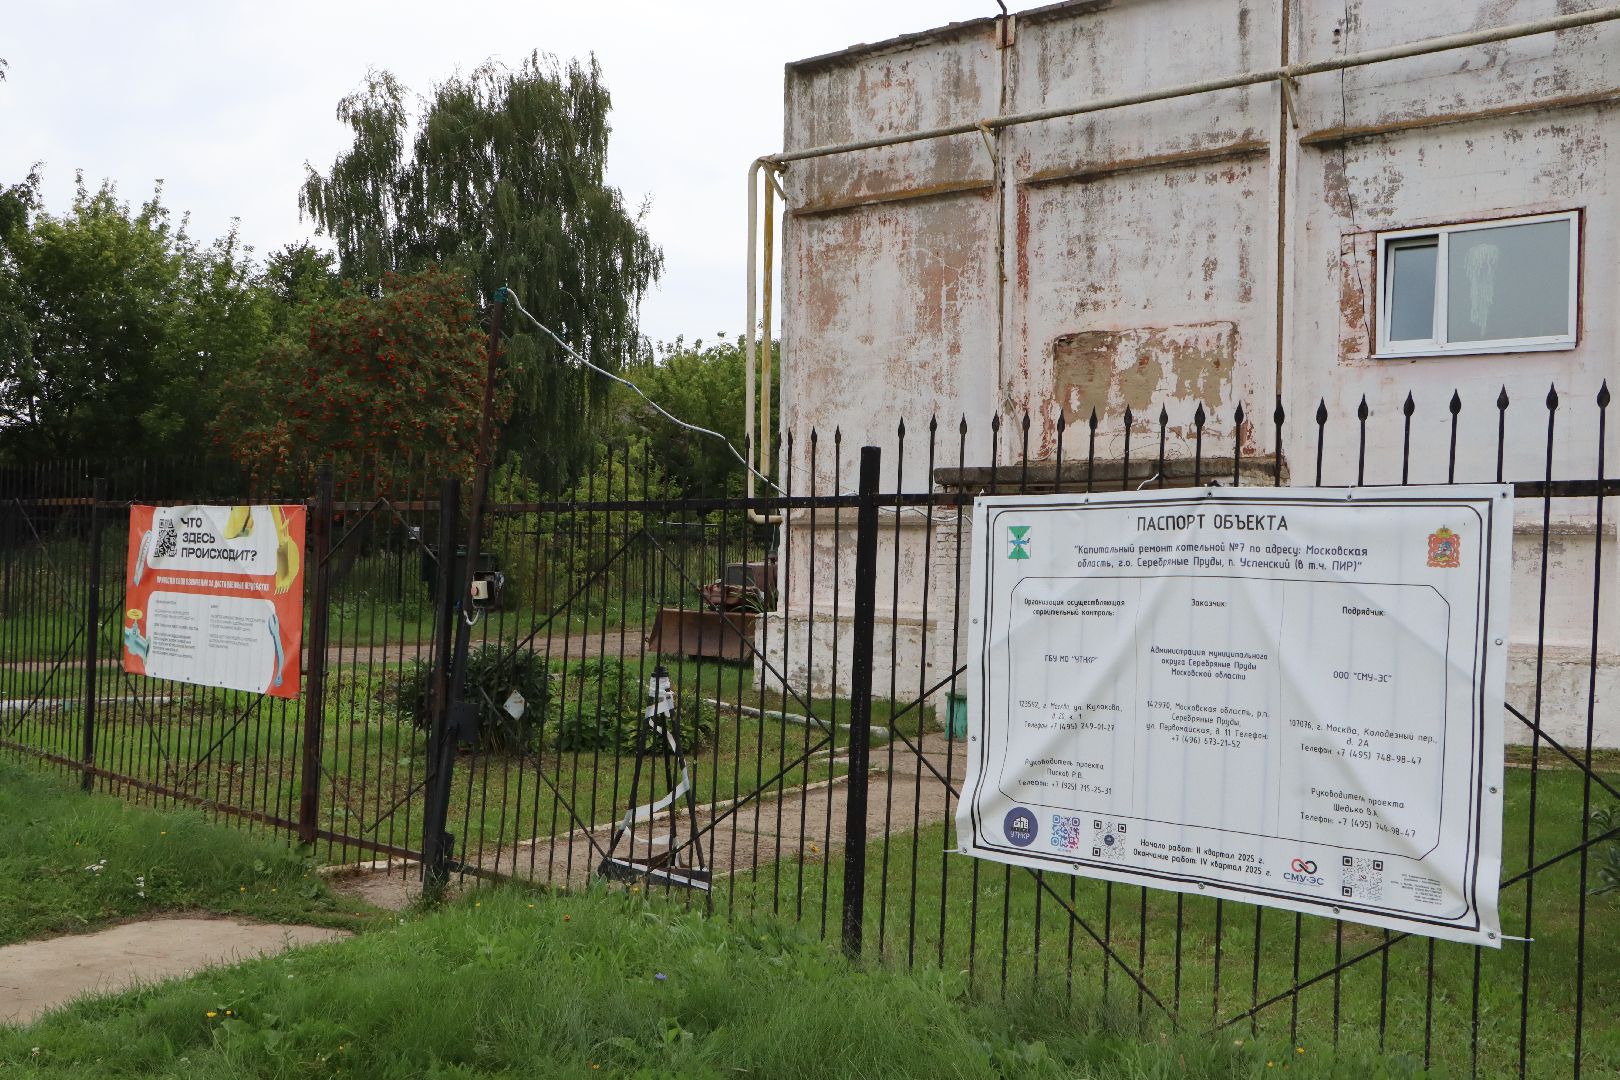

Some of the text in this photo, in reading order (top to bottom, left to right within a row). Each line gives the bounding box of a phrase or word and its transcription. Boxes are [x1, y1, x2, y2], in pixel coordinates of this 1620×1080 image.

[181, 517, 202, 528] ЧТО
[1137, 514, 1288, 531] ПАСПОРТ ОБЪЕКТА
[182, 532, 215, 543] ЗДЕСЬ
[181, 547, 257, 561] ПРОИСХОДИТ?
[1075, 544, 1134, 554] "Капитальный
[1139, 545, 1172, 555] ремонт
[1176, 542, 1225, 552] котельной
[1229, 542, 1244, 552] №7
[1266, 544, 1301, 556] адресу:
[1306, 545, 1368, 556] Московская
[1078, 559, 1114, 568] область,
[1138, 558, 1189, 568] Серебряные
[1194, 556, 1224, 568] Пруды,
[1240, 558, 1290, 569] Успенский
[1295, 559, 1303, 570] (в
[1309, 562, 1326, 570] т.ч.
[1332, 561, 1363, 572] ПИР)"
[1151, 646, 1268, 660] Администрация муниципального
[1162, 658, 1257, 671] округа Серебряные Пруды
[1171, 668, 1246, 680] Московской области
[1333, 671, 1349, 680] ООО
[1175, 703, 1216, 713] Московская
[1172, 714, 1214, 723] Серебряные
[1326, 724, 1360, 736] Москва,
[1364, 728, 1414, 741] Колодезный
[1349, 750, 1371, 761] (495)
[1311, 788, 1404, 809] Руководитель проекта
[1351, 818, 1372, 830] (495)
[1140, 838, 1166, 850] Начало
[1168, 843, 1193, 854] работ:
[1204, 847, 1235, 860] квартал
[1238, 852, 1255, 862] 2025
[1133, 848, 1169, 861] Окончание
[1200, 855, 1209, 866] IV
[1210, 858, 1243, 872] квартал
[1245, 864, 1262, 875] 2025
